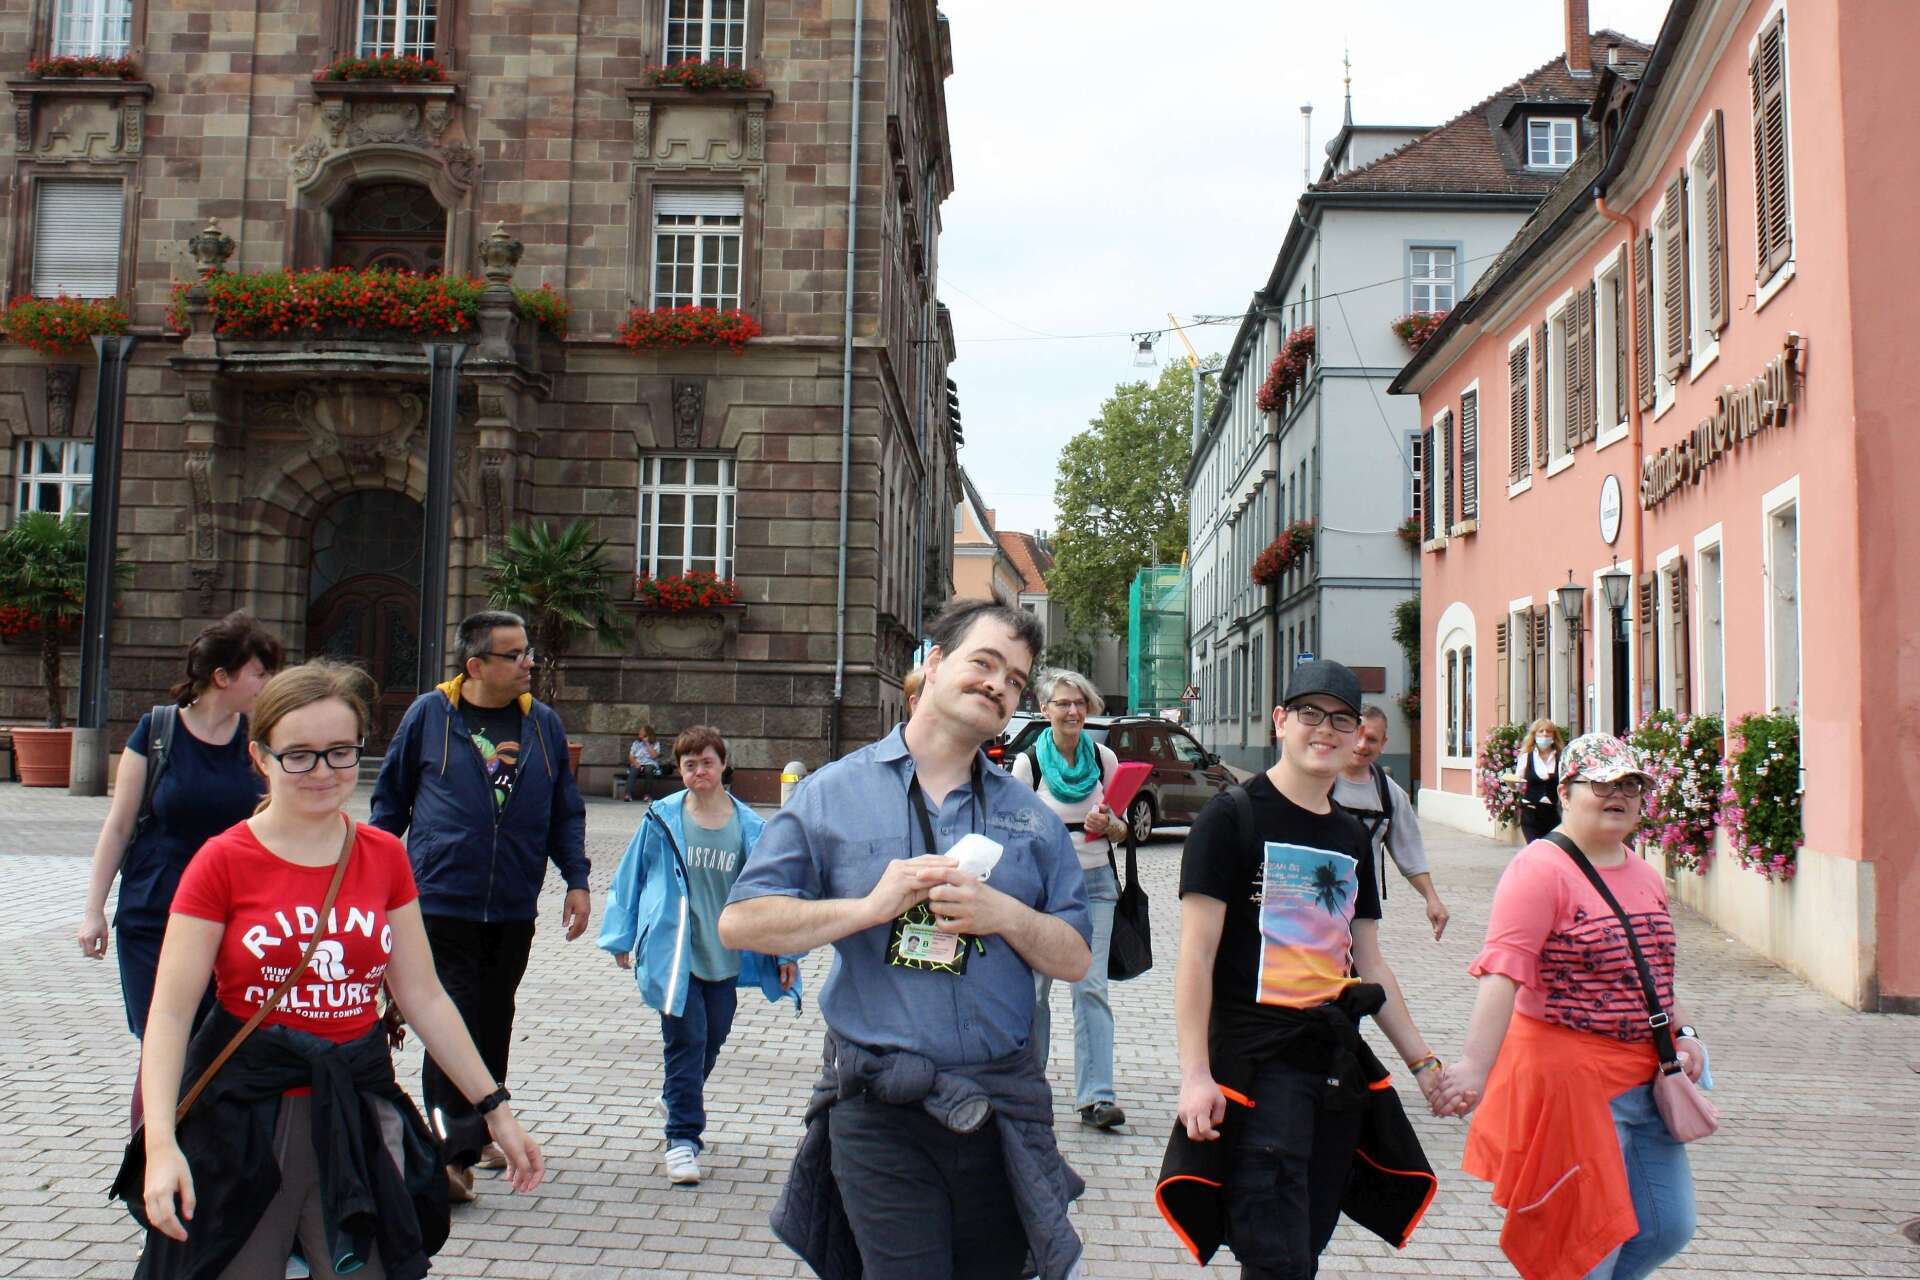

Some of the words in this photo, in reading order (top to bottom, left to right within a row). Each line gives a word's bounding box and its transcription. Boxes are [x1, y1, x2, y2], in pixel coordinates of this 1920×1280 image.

[687, 845, 736, 872] USTANG
[241, 906, 392, 960] RIDING
[244, 982, 376, 1009] CULTURE
